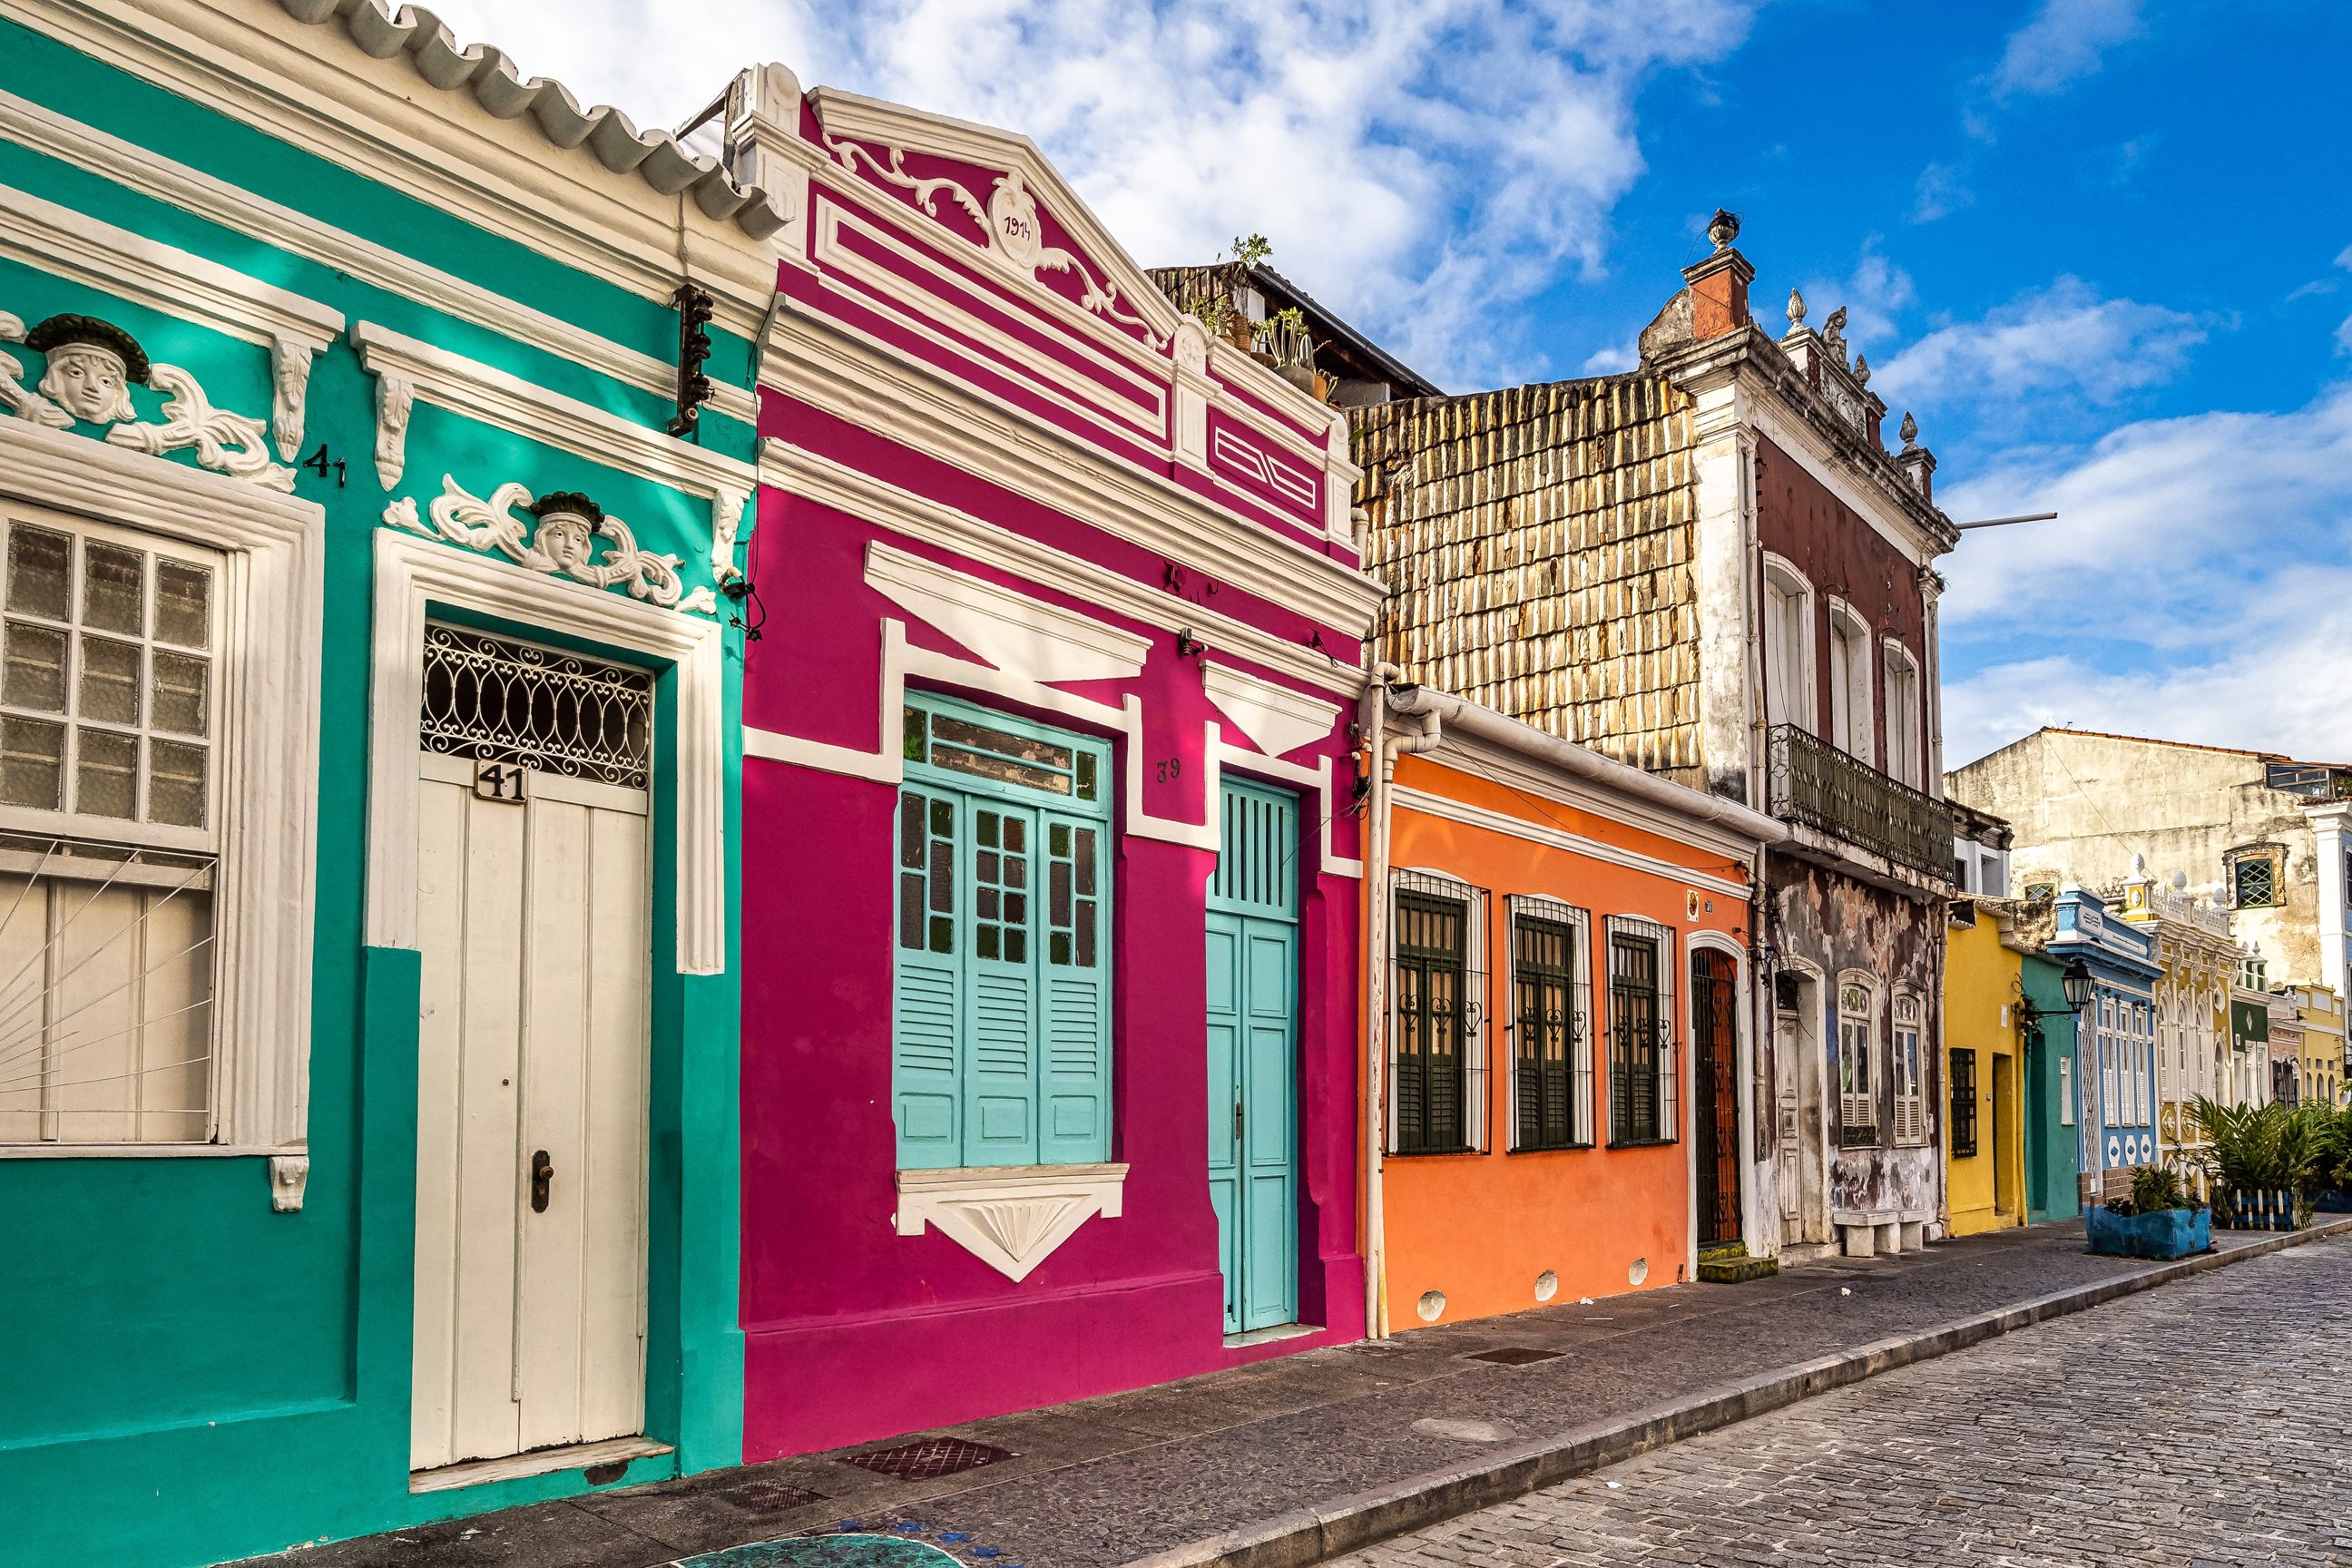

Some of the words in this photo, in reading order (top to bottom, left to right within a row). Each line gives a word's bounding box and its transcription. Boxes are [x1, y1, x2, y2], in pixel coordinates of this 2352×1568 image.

[1004, 216, 1030, 241] 1914
[303, 443, 346, 488] 41
[479, 764, 525, 800] 41
[1157, 758, 1181, 784] 39
